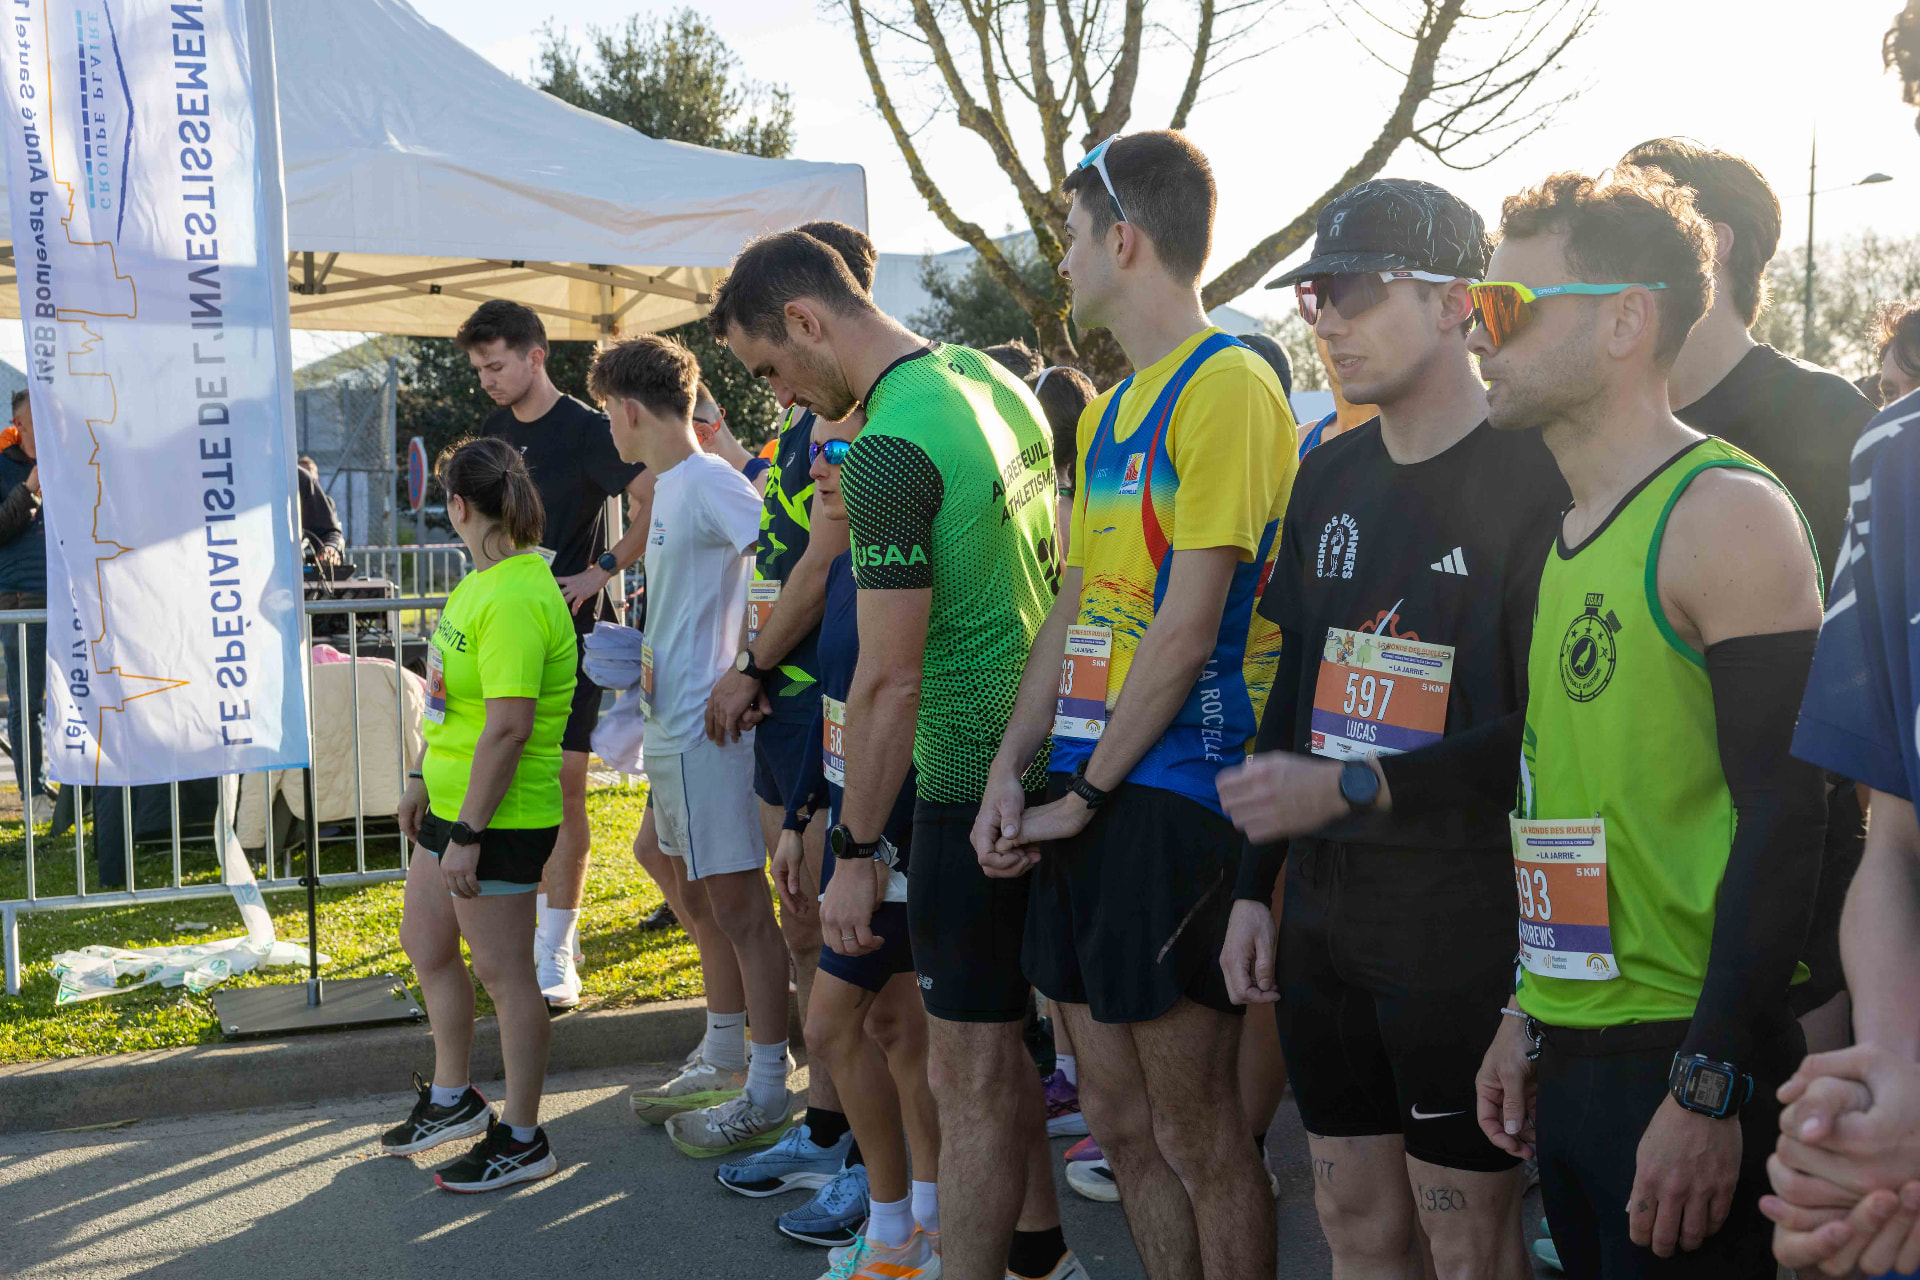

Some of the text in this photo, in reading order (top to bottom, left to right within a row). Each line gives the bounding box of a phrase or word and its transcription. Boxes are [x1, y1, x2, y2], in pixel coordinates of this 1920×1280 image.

[856, 544, 928, 567] USAA
[1340, 513, 1359, 579] RUNNERS
[1343, 672, 1395, 721] 597
[1421, 683, 1444, 694] 5 KM
[1200, 688, 1225, 762] ROCELLE
[1346, 719, 1377, 742] LUCAS
[830, 724, 845, 757] 58
[1528, 826, 1549, 835] RONDE
[1550, 826, 1564, 834] DES
[1566, 826, 1601, 834] RUELLES
[1550, 852, 1575, 860] JARRIE
[1576, 867, 1600, 877] 5 KM
[1418, 1185, 1465, 1211] 1930
